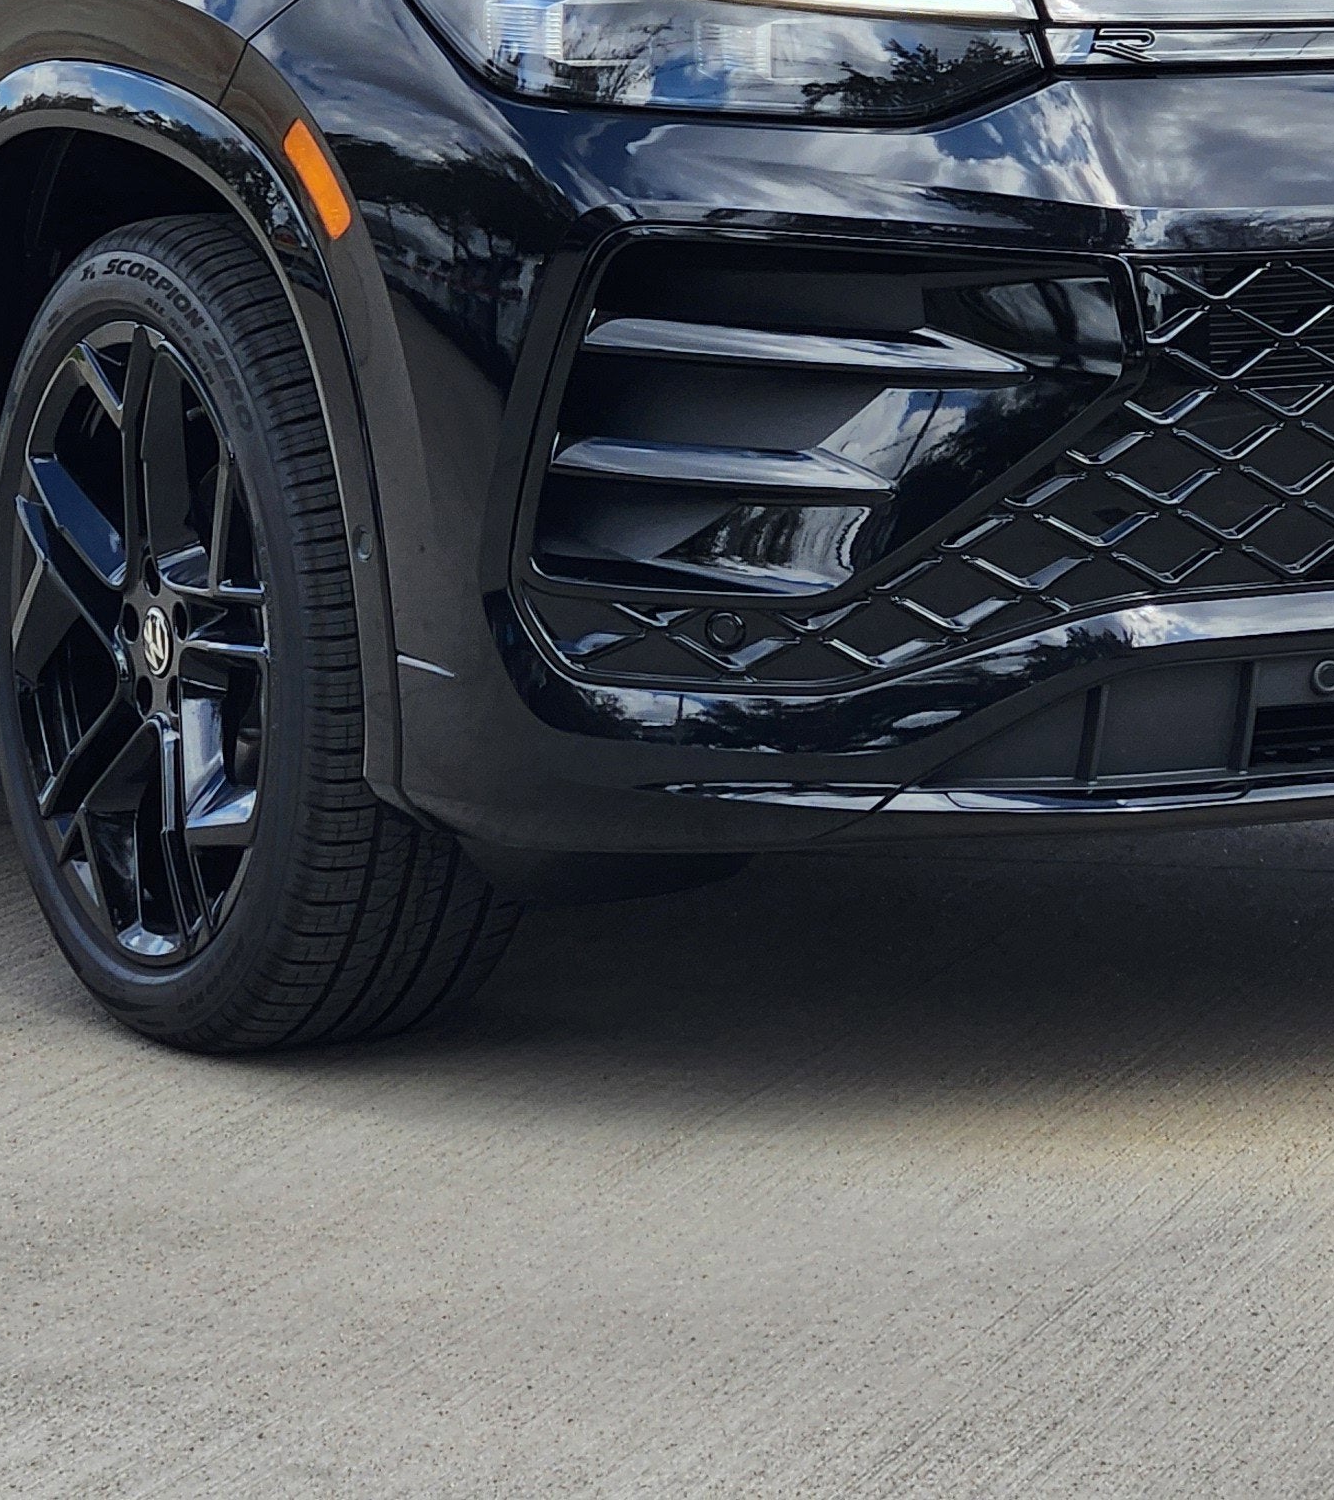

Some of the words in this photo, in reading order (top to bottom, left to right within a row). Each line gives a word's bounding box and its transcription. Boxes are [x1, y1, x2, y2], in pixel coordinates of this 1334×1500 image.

[1093, 27, 1161, 63] R
[101, 258, 205, 330] SCORPION
[202, 337, 253, 432] ZERO
